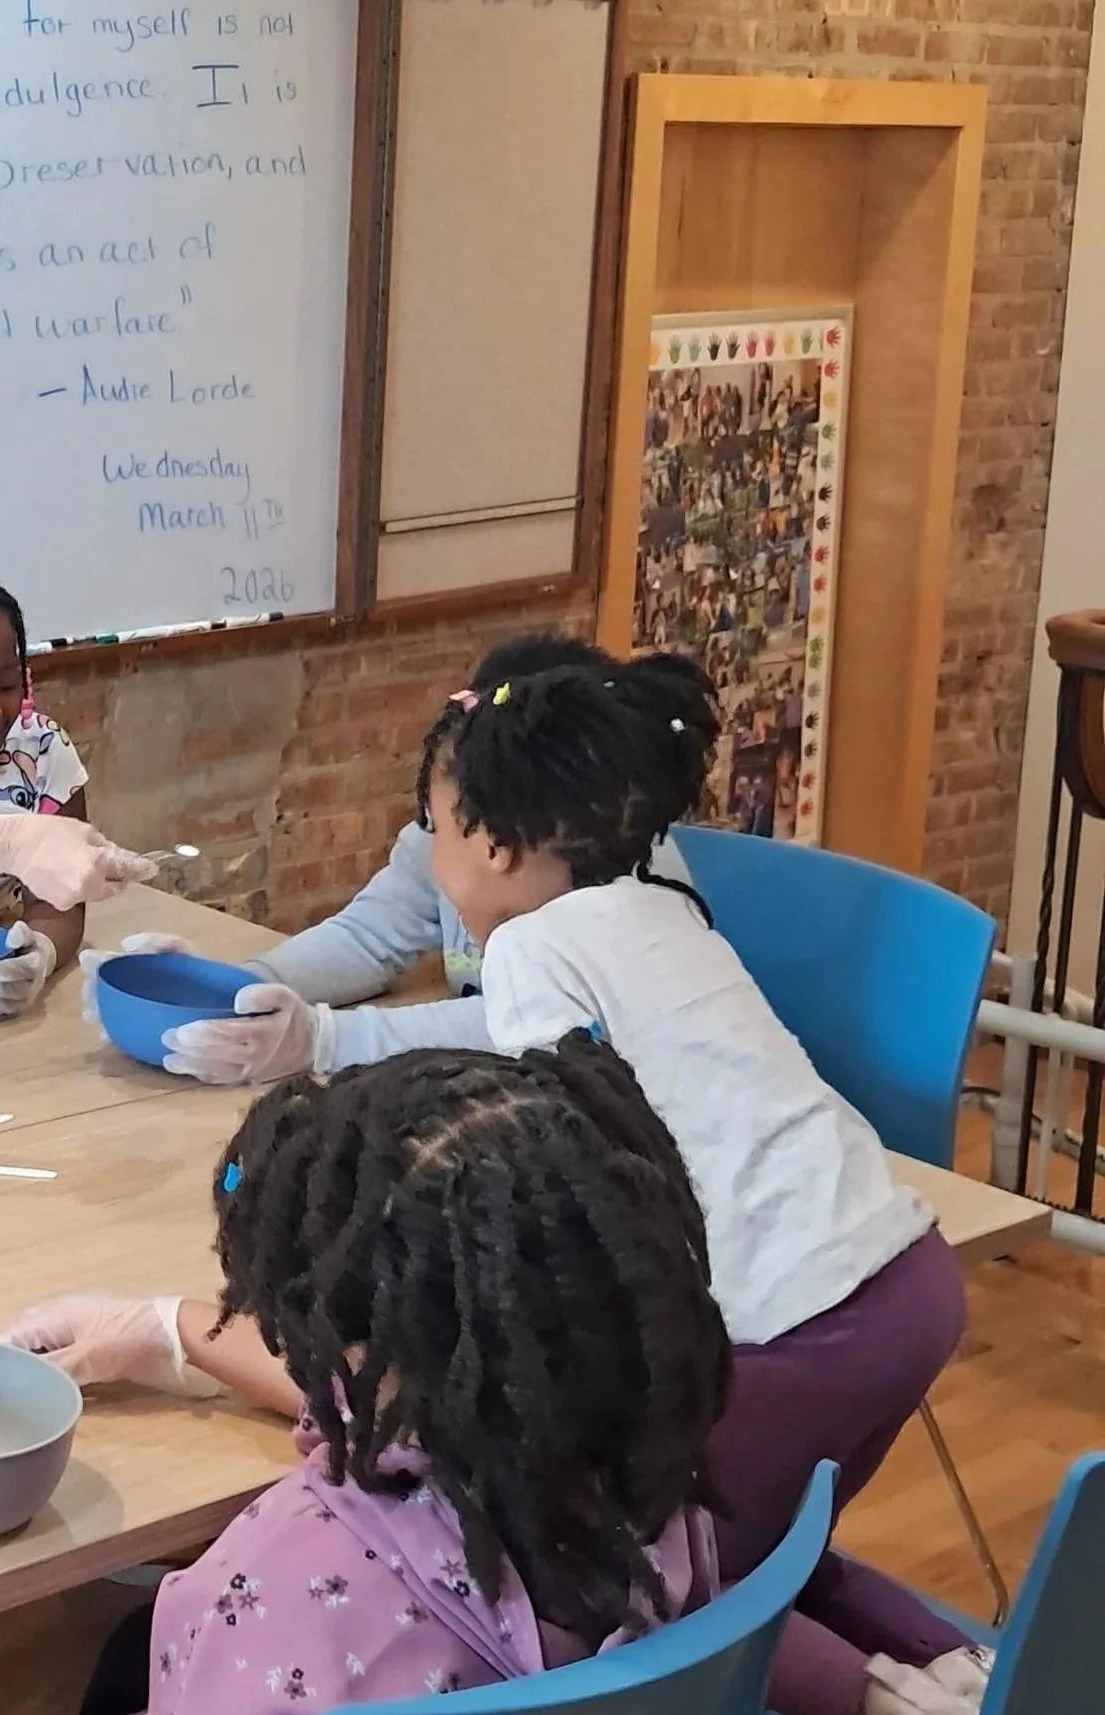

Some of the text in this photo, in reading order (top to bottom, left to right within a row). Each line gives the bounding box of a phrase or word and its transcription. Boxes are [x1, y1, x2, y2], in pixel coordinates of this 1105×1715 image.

[23, 0, 72, 36] for
[92, 8, 191, 52] myself
[217, 14, 239, 36] is
[258, 13, 294, 36] not
[191, 64, 249, 108] It
[273, 68, 299, 104] is
[245, 144, 308, 176] and
[39, 243, 85, 268] an
[99, 237, 156, 265] act
[178, 220, 218, 261] of
[82, 364, 152, 406] Audre
[169, 368, 255, 406] Lorde
[101, 447, 252, 506] Wednesday
[139, 500, 226, 533] March
[220, 565, 295, 605] 2026
